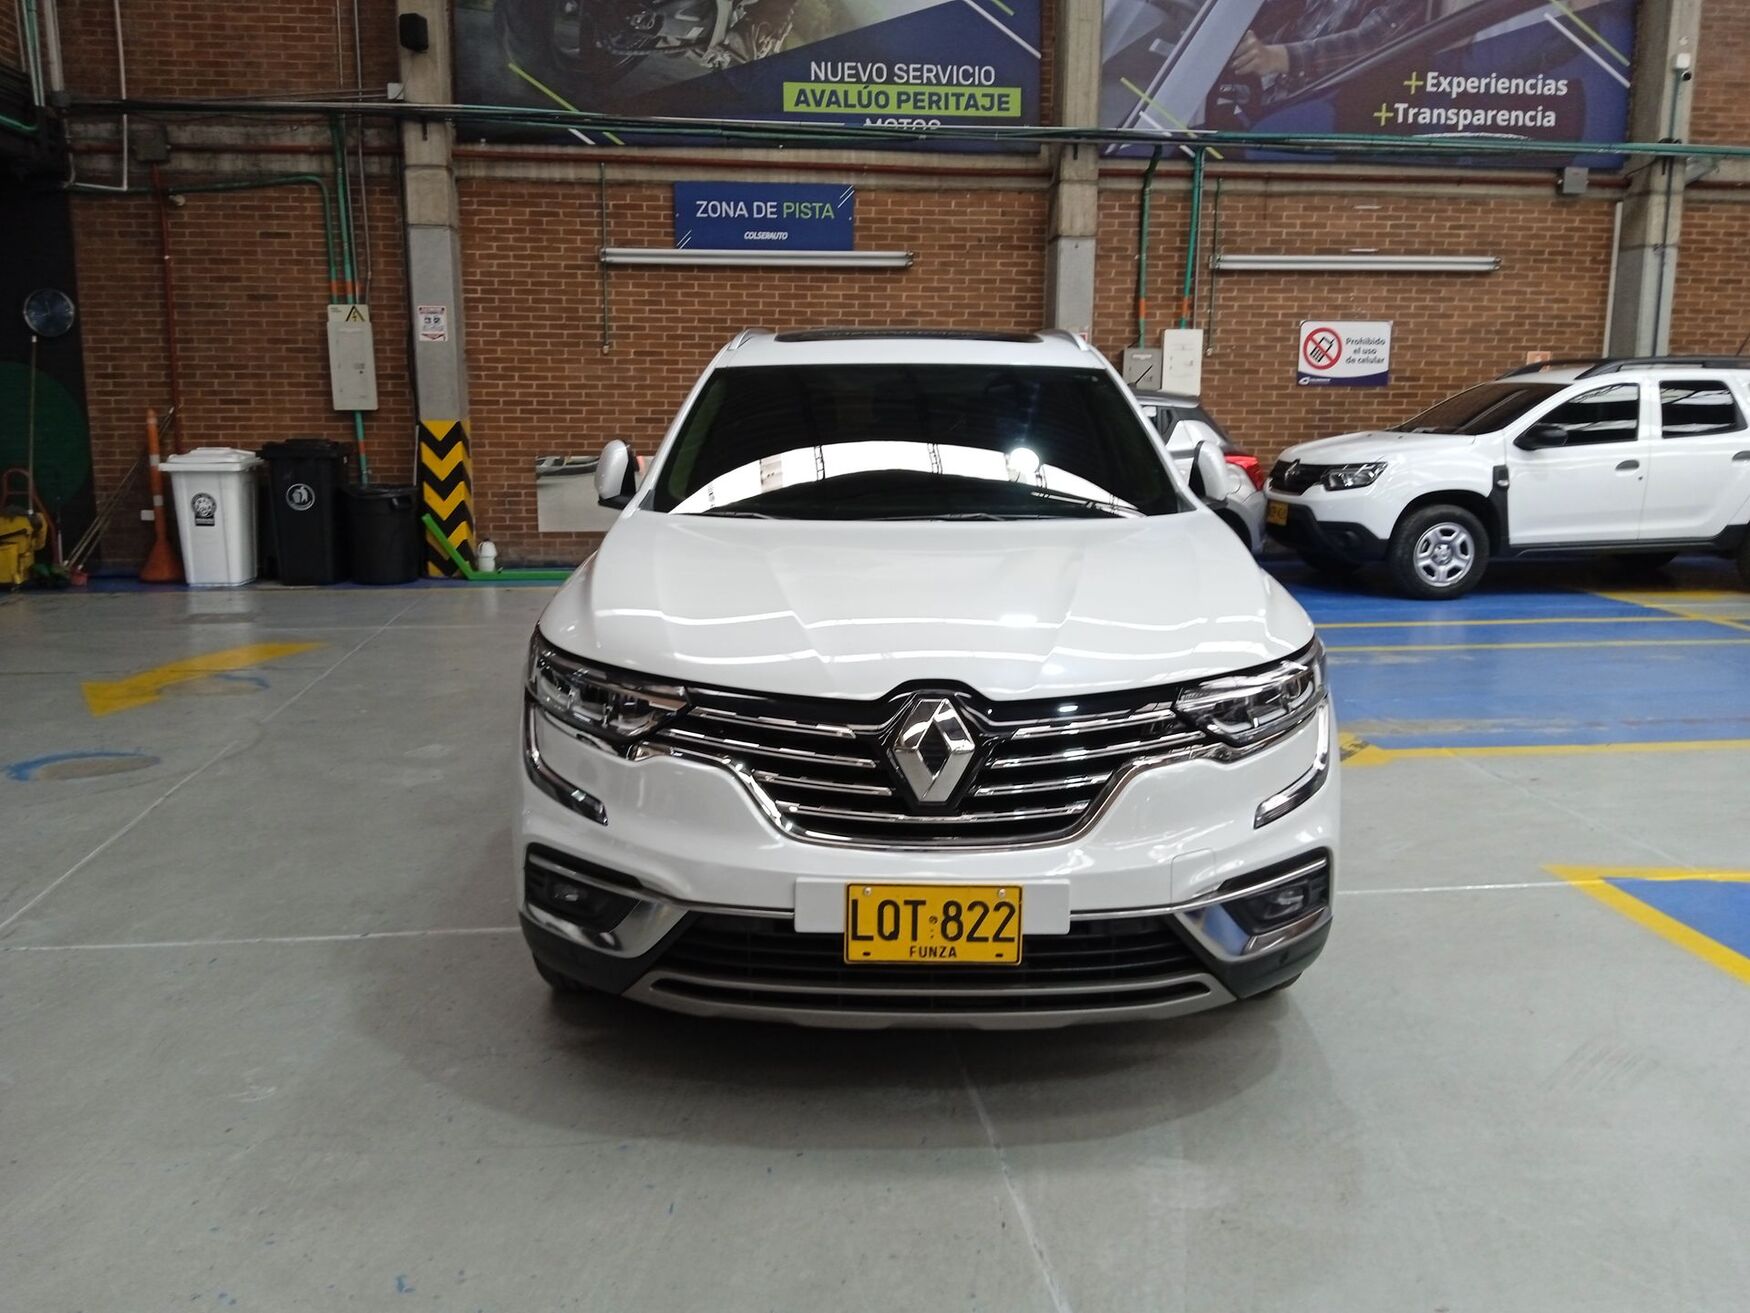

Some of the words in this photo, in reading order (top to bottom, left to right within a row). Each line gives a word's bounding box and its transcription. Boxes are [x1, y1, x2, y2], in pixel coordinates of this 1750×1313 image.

[810, 61, 888, 83] NUEVO
[893, 63, 996, 86] SERVICIO
[793, 85, 890, 109] AVALÚO
[896, 91, 1011, 112] PERITAJE
[695, 200, 749, 218] ZONA
[752, 202, 778, 219] DE
[782, 202, 835, 220] PISTA
[1345, 336, 1386, 346] Prohibido
[1353, 346, 1361, 355] el
[1345, 355, 1356, 364] de
[1357, 355, 1385, 364] celular
[940, 899, 1017, 943] 822
[909, 945, 958, 959] FUNZA
